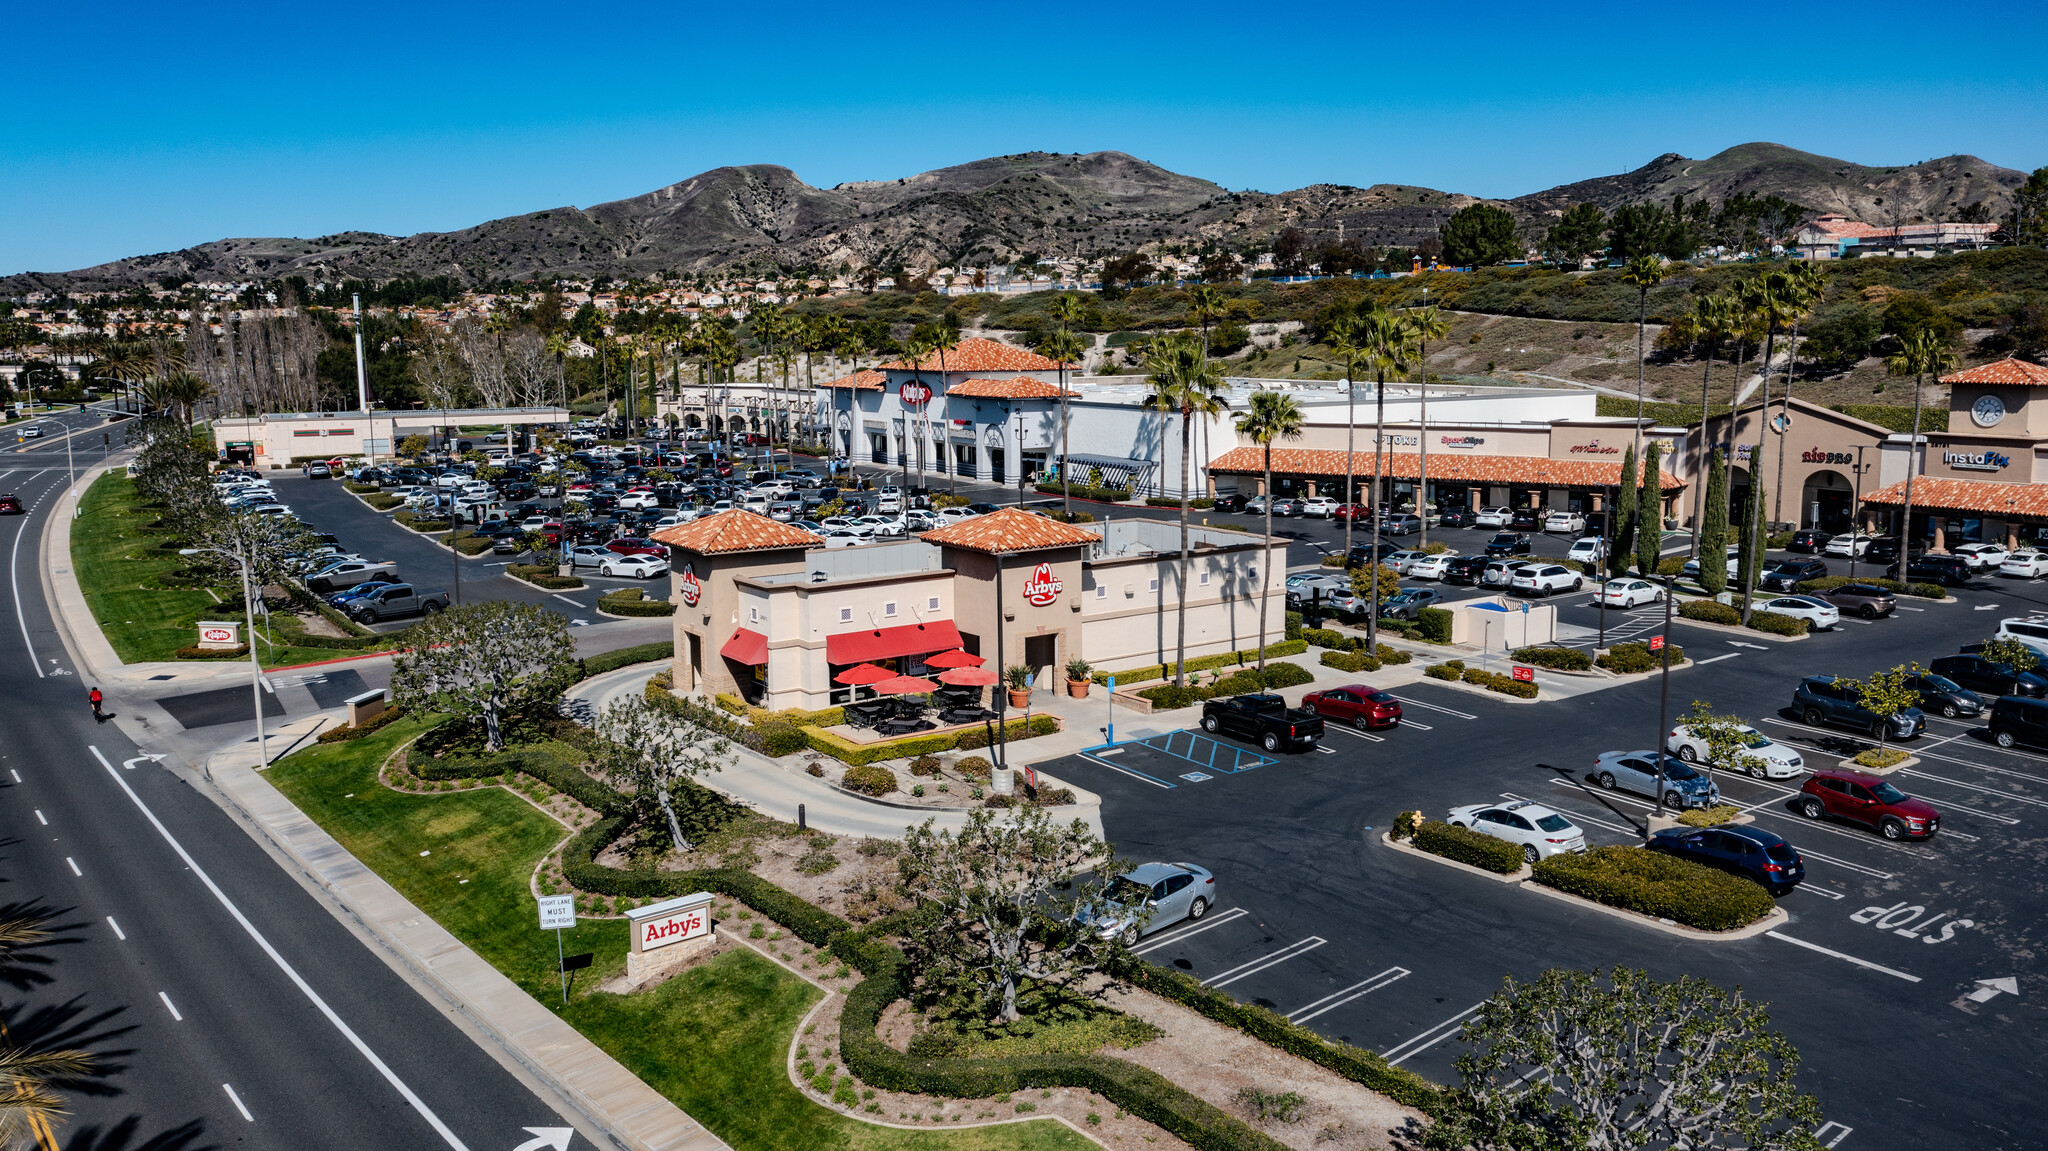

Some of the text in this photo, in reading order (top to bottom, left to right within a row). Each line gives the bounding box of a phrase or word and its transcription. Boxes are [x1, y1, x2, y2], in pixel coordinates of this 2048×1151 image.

[1943, 449, 2010, 467] InstaFix
[1024, 577, 1063, 596] Arby's
[207, 629, 229, 641] Ralphs
[645, 913, 701, 942] Arby's
[1850, 901, 1974, 944] STOP
